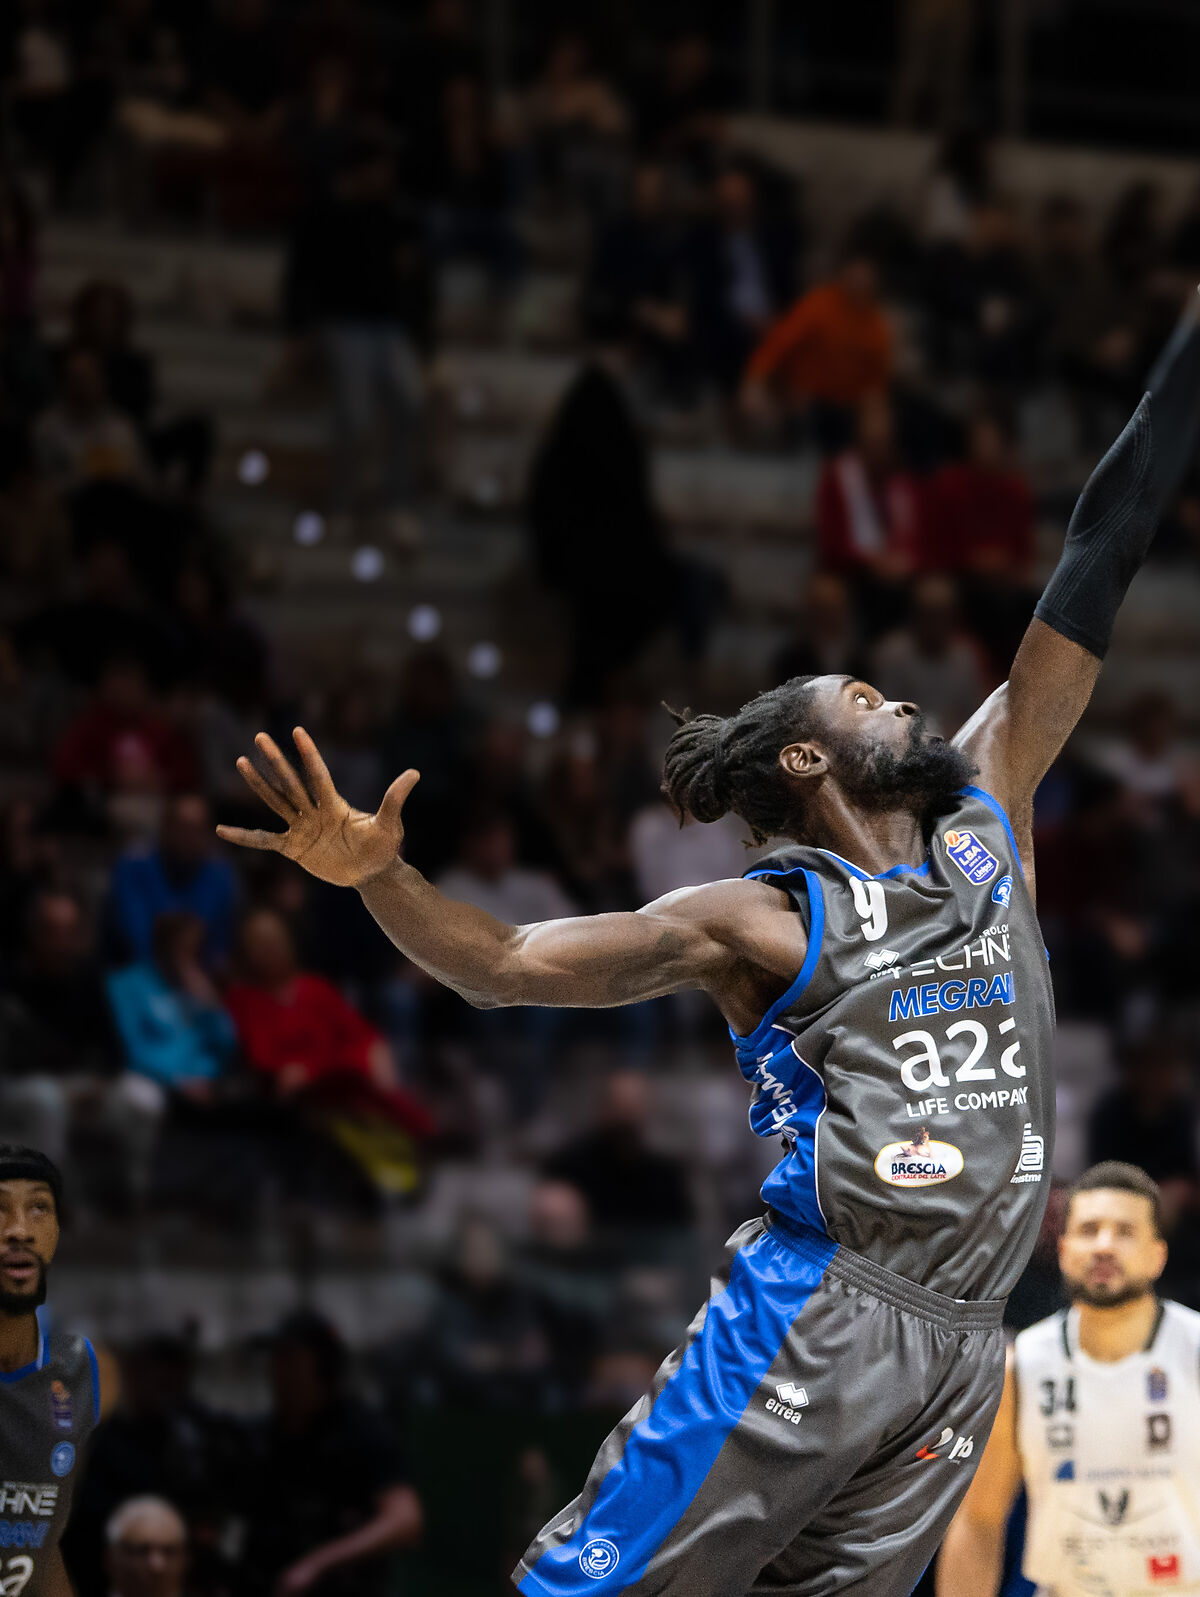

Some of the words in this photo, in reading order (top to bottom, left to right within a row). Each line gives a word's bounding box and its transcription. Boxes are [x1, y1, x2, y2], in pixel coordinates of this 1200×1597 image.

[958, 845, 982, 866] LBA
[849, 876, 888, 941] 9
[888, 970, 1016, 1022] MEGRA
[906, 1098, 950, 1117] LIFE
[954, 1086, 1028, 1111] COMPAY
[891, 1162, 946, 1175] BRESCIA
[765, 1398, 802, 1425] errea
